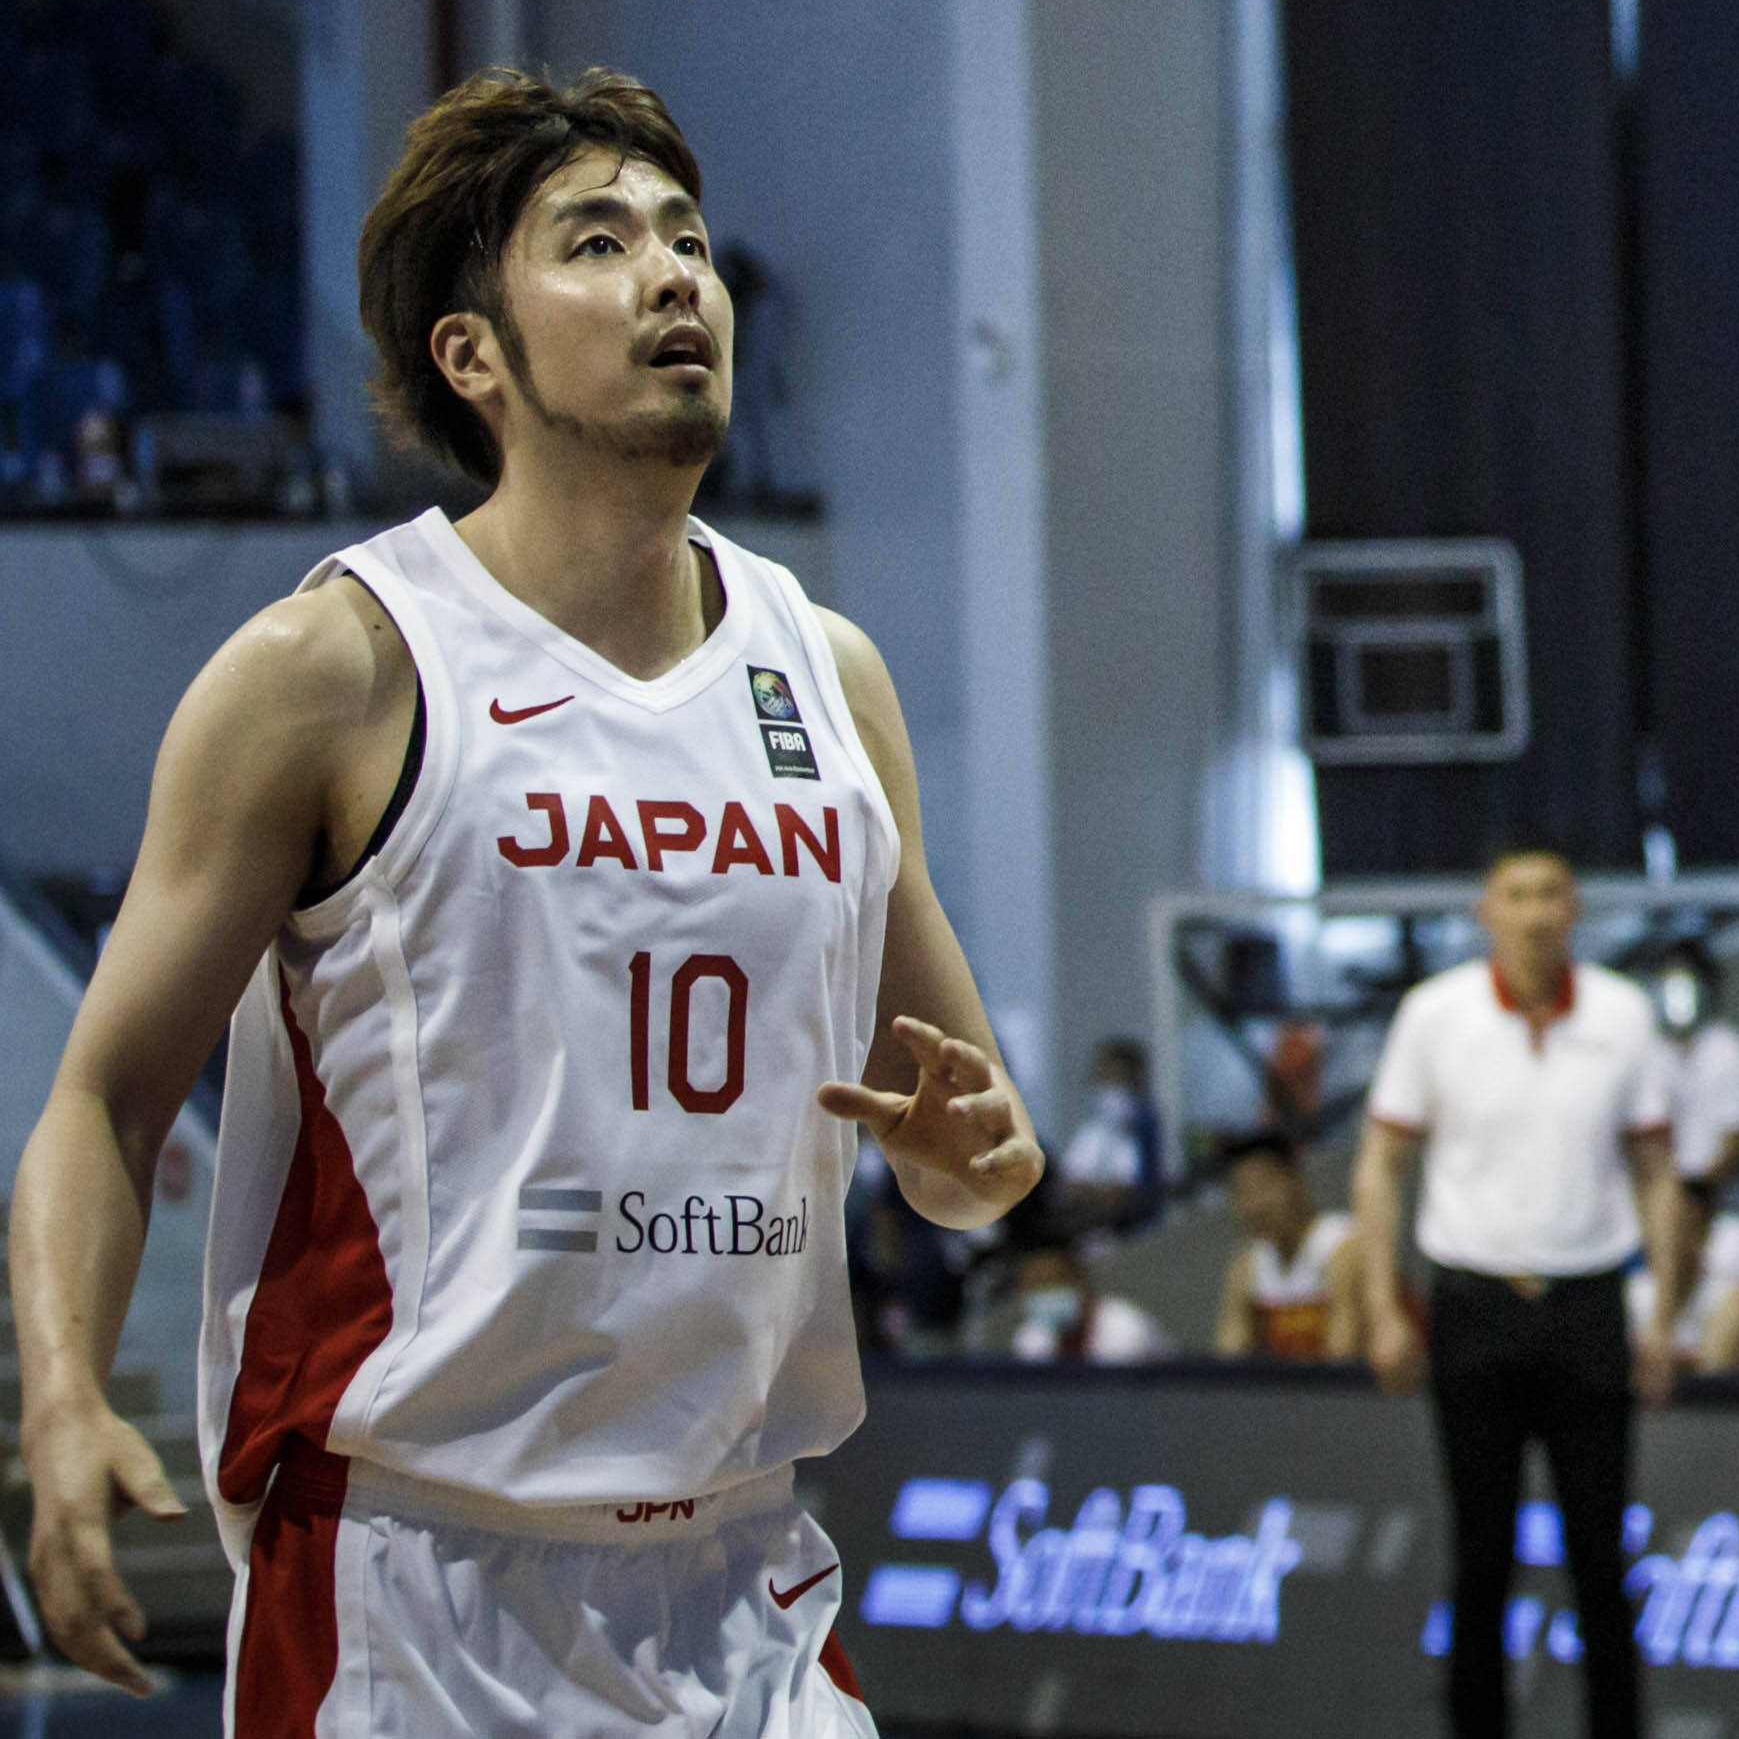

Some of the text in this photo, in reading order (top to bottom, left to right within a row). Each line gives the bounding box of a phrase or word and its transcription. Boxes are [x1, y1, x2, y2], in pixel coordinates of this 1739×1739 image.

[768, 730, 806, 752] FIBA
[497, 792, 842, 884] JAPAN
[628, 951, 749, 1115] 10
